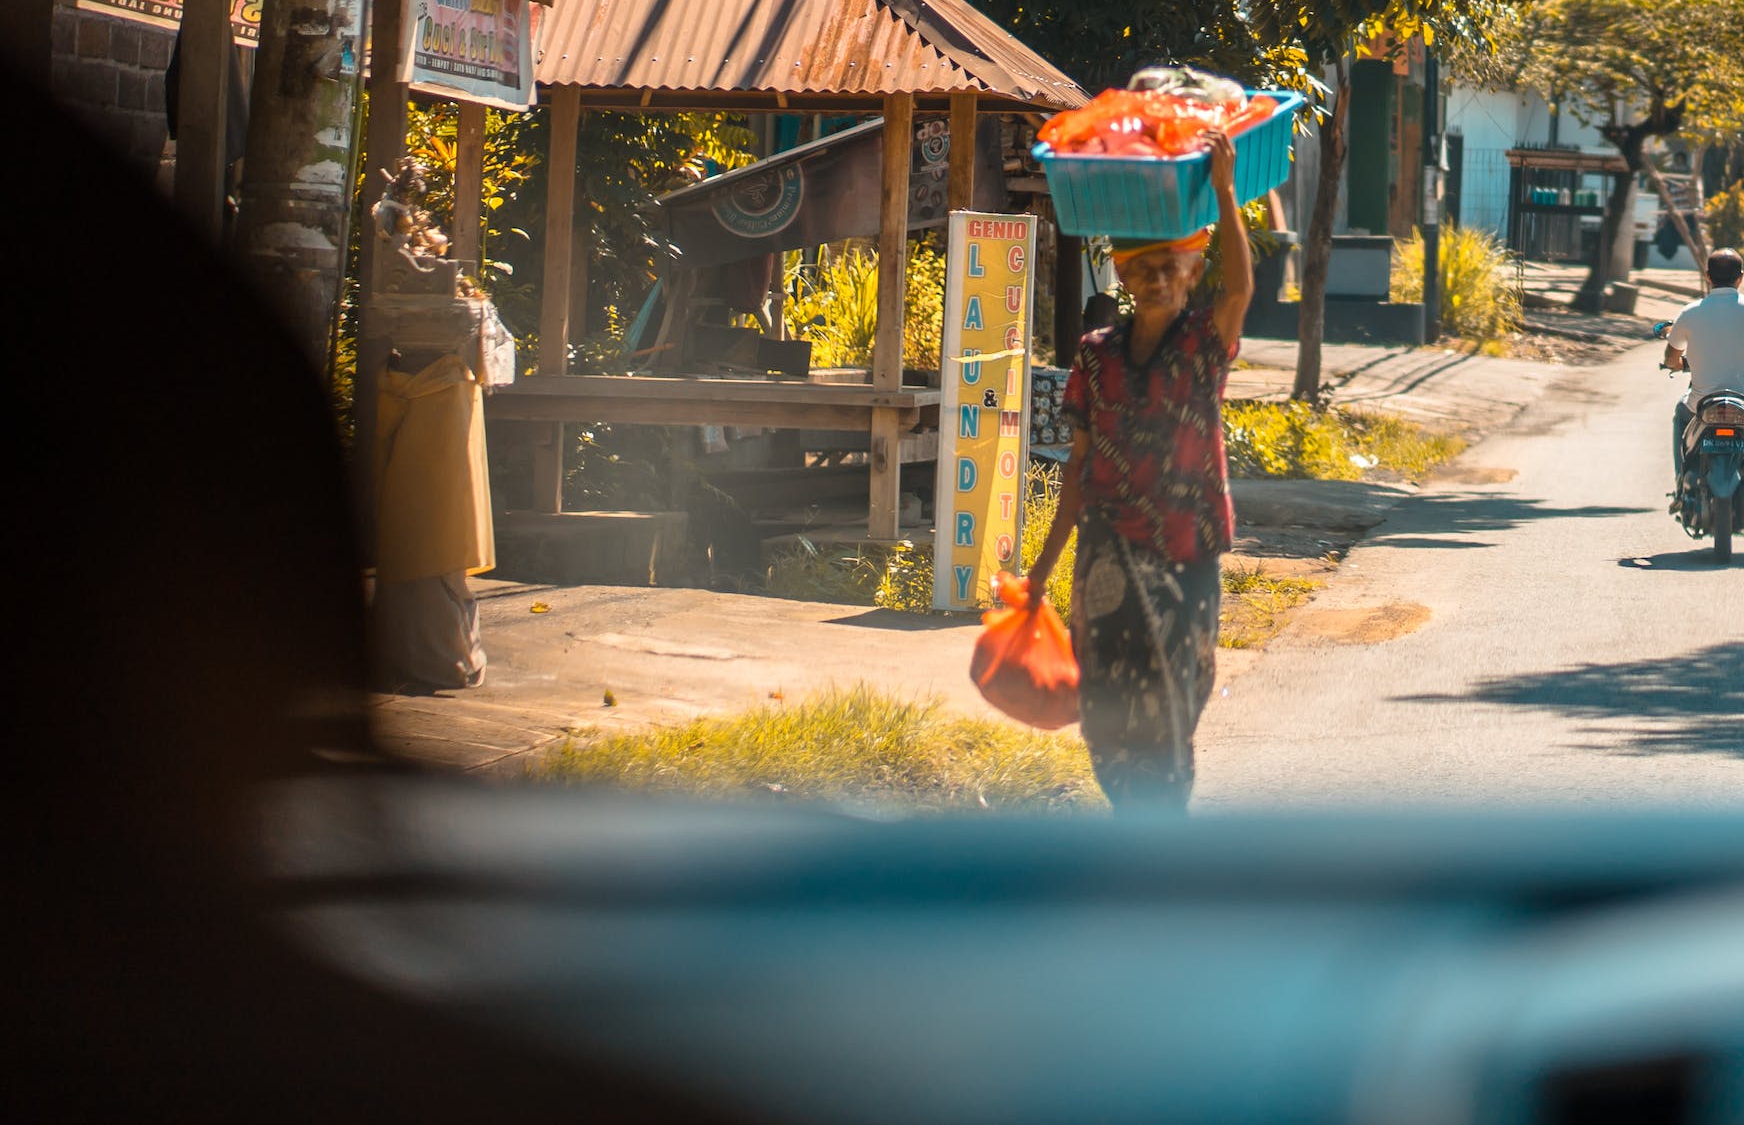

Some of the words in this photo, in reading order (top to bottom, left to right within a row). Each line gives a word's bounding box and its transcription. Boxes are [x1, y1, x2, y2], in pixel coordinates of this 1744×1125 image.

[422, 15, 456, 57] Cuci
[968, 219, 1028, 240] GENIO
[1003, 245, 1024, 396] CUCI
[953, 243, 984, 601] LAUNDRY
[983, 388, 998, 408] &
[994, 409, 1020, 603] MOTO
